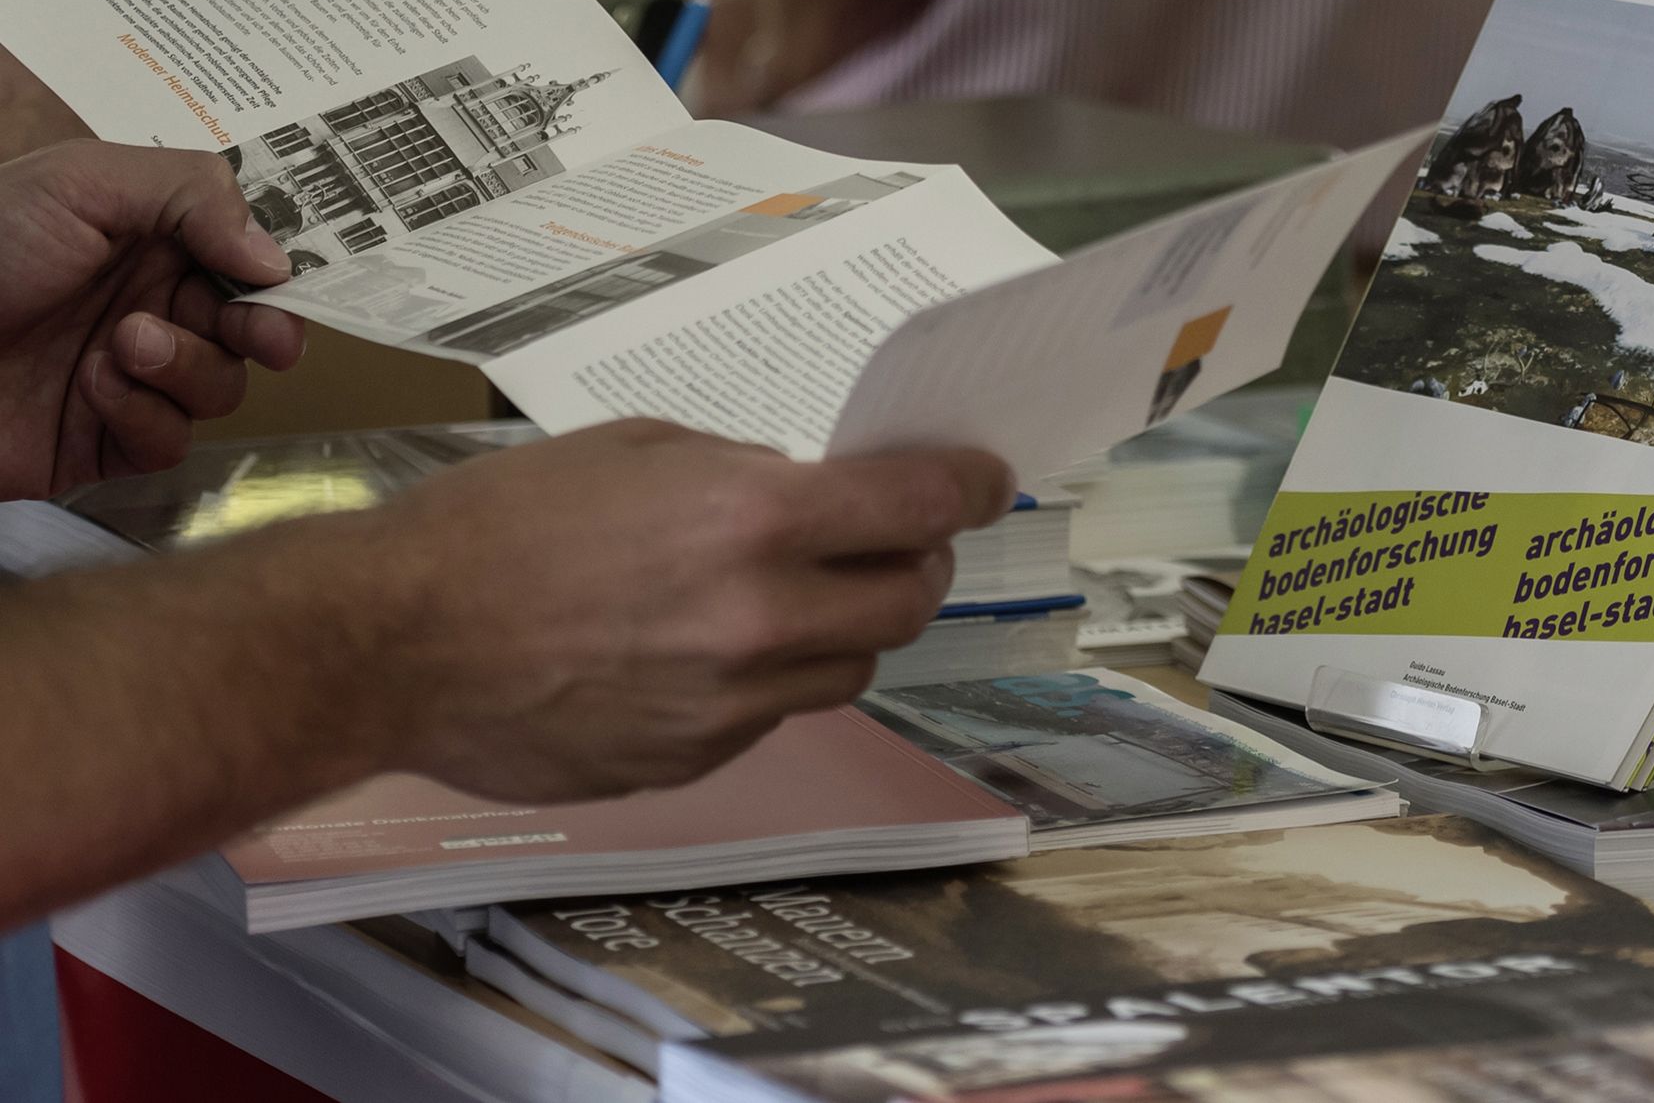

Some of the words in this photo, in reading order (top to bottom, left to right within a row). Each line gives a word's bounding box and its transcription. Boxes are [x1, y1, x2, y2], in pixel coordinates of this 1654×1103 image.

[117, 33, 166, 77] Moderner
[164, 72, 232, 147] Heimatschutz
[1258, 524, 1498, 601] bodenforschung
[1410, 660, 1424, 672] Guido
[1426, 665, 1446, 677] Lassau
[1403, 674, 1445, 691] Archäologische
[1445, 683, 1490, 703] Bodenforschung
[1490, 695, 1526, 712] Basel-Stadt
[553, 904, 659, 952] Tore
